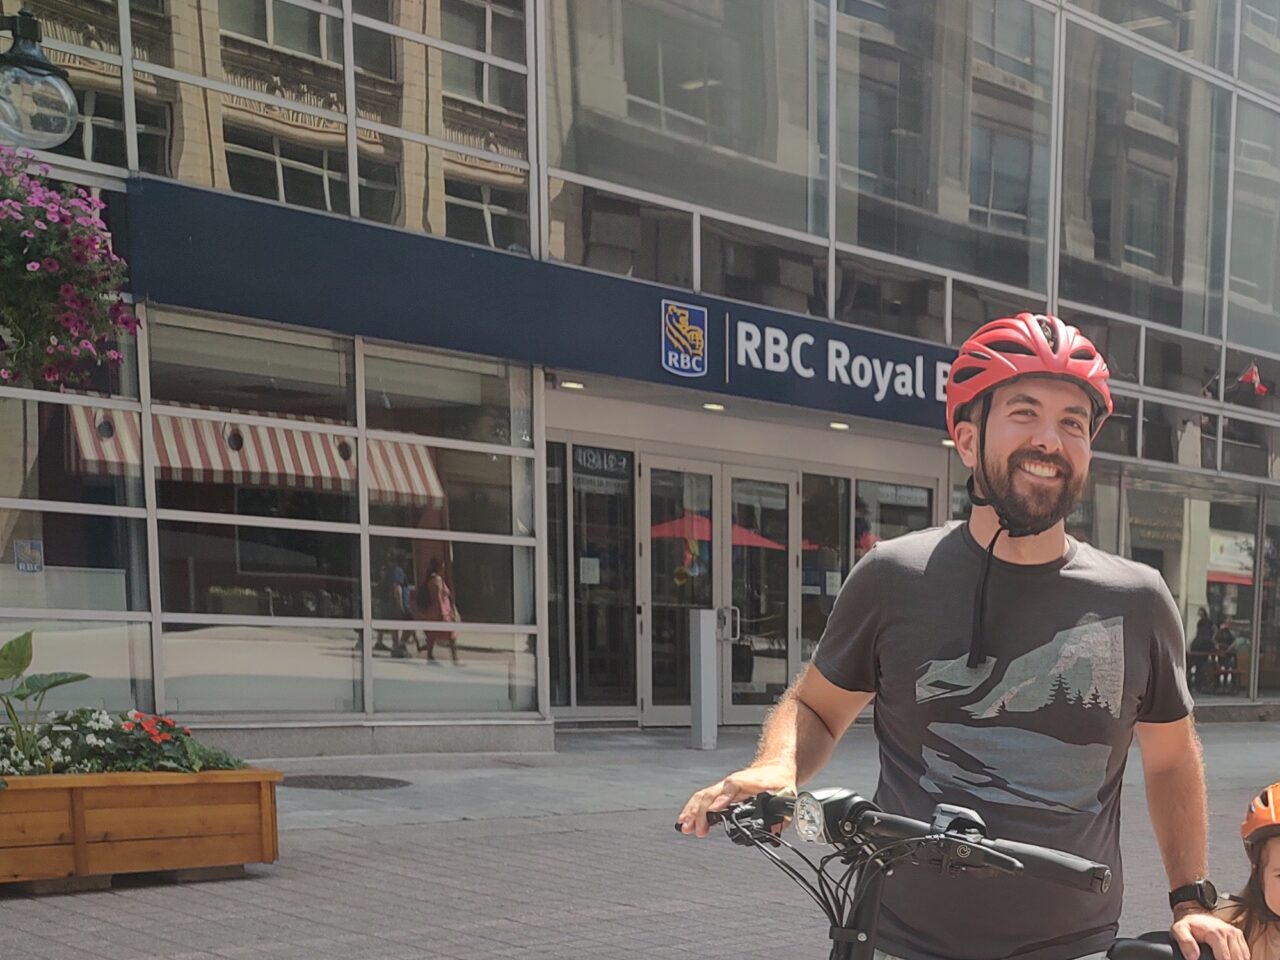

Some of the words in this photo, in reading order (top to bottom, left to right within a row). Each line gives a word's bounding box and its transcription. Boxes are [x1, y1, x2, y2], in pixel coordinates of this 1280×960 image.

[667, 350, 703, 372] RBC
[736, 320, 816, 378] RBC
[827, 339, 926, 402] Royal
